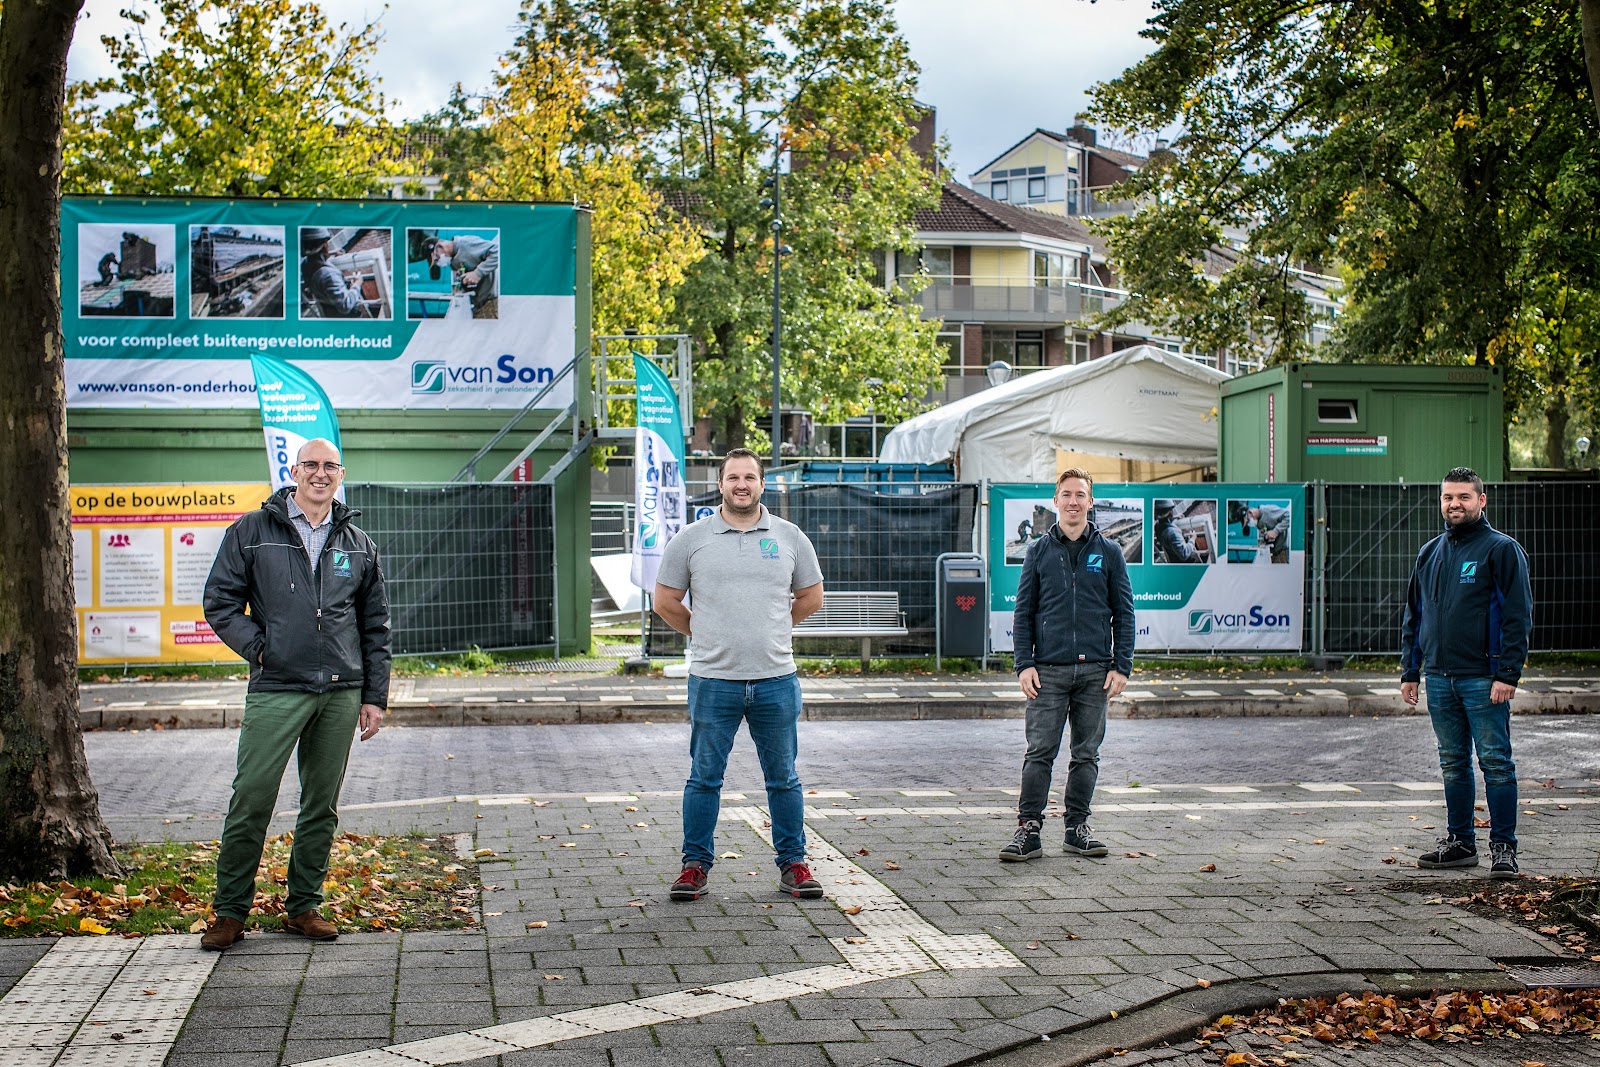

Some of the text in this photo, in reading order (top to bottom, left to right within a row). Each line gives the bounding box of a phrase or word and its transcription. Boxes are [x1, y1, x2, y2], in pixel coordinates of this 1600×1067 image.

[78, 333, 392, 350] voor compleet buitengevelonderhoud
[447, 354, 554, 384] van Son
[78, 380, 257, 393] www.vanson-onderhou
[447, 385, 554, 394] zekerheid in gevelonderhd
[76, 490, 235, 510] op de bouwplaats
[1213, 605, 1290, 627] van Son
[176, 635, 202, 643] corona
